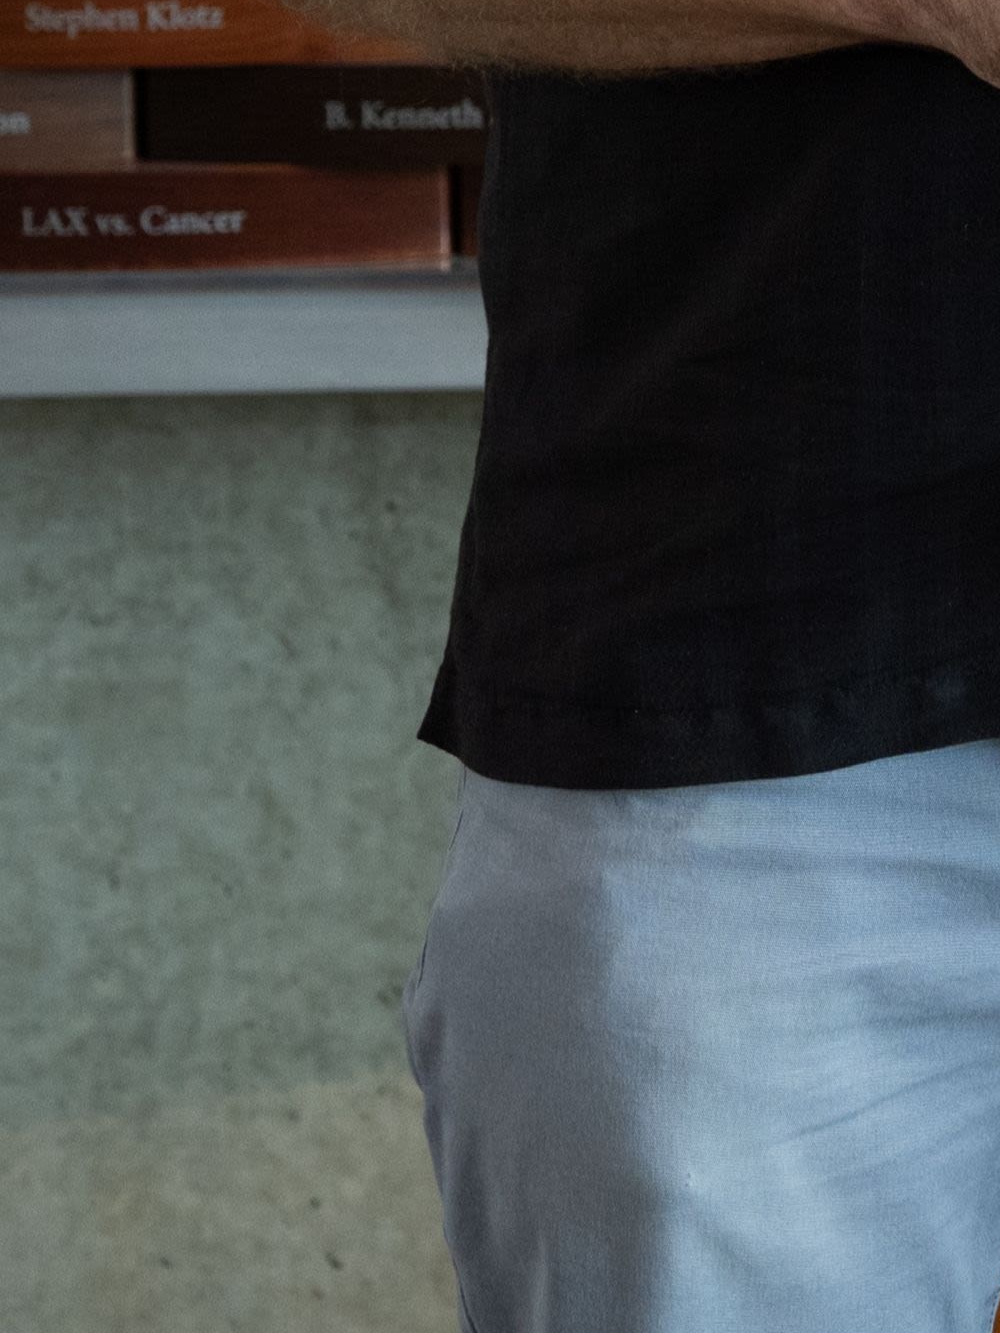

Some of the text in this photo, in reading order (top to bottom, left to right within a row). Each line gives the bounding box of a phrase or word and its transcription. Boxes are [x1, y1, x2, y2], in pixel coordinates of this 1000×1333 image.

[24, 0, 225, 39] Stephen Klotz
[324, 99, 484, 131] B. Kenneth
[21, 205, 247, 237] LAX vs. Cancer
